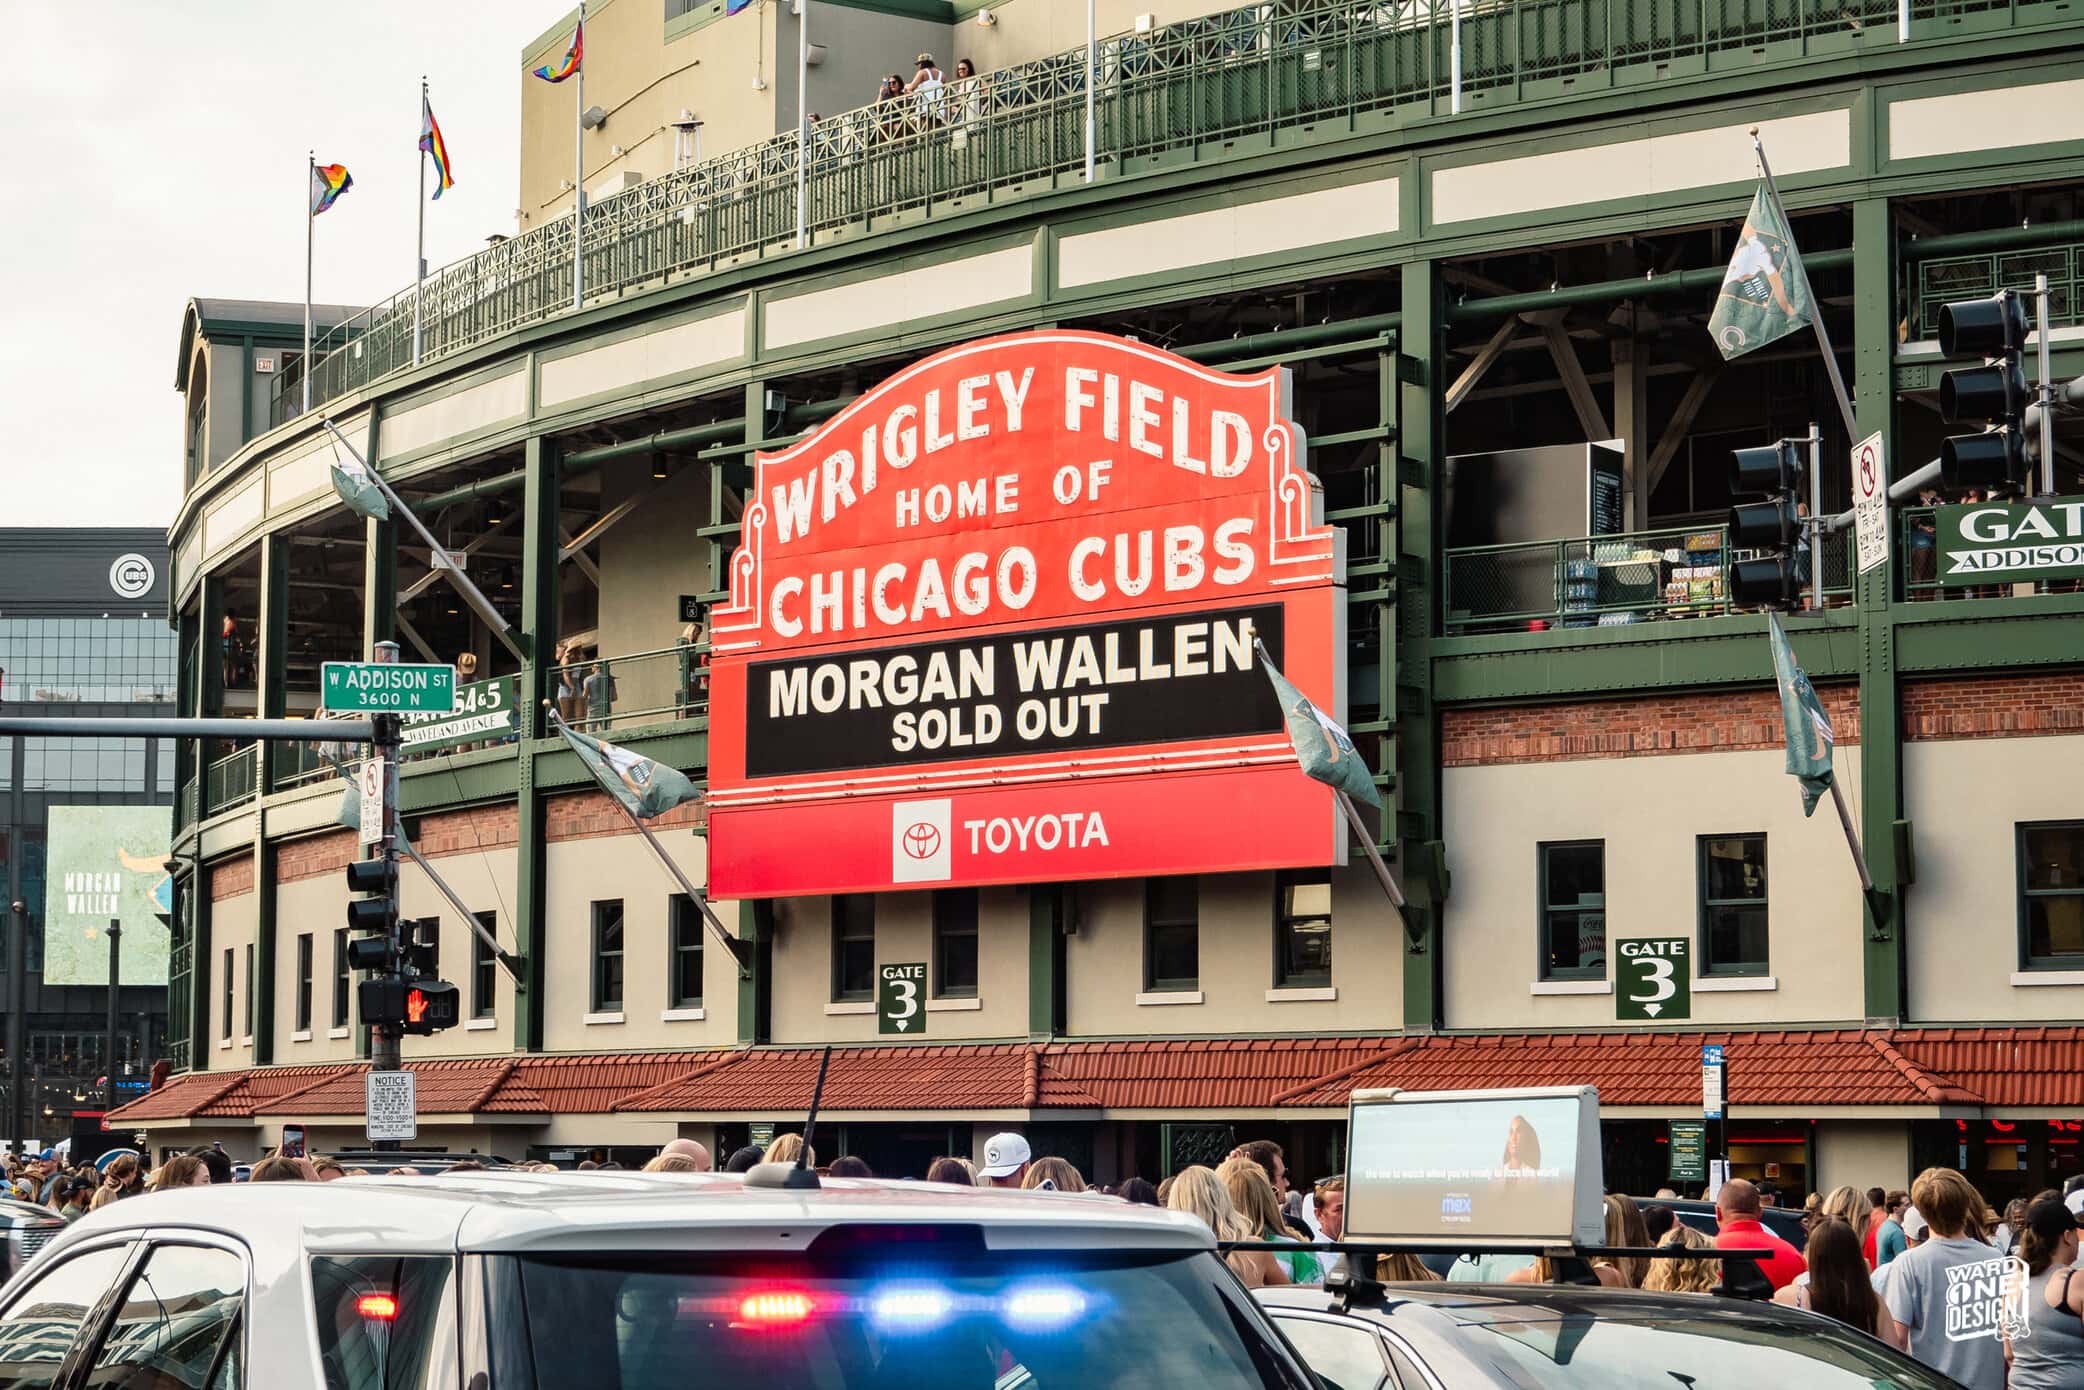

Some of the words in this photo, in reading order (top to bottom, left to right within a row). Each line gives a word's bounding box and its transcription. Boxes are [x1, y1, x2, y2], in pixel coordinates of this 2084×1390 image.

[772, 367, 1034, 543] WRIGLEY
[1065, 367, 1253, 478] FIELD
[896, 474, 1019, 527] HOME
[1053, 460, 1113, 504] OF
[1961, 545, 2084, 569] ADDISO
[769, 546, 1036, 637] CHICAGO
[1068, 518, 1255, 602] CUBS
[769, 646, 995, 718] MORGAN
[1013, 617, 1254, 696] WALLEN
[330, 672, 340, 686] W
[346, 671, 428, 690] ADDISON
[433, 674, 448, 687] ST
[359, 693, 401, 705] 3600
[410, 694, 420, 706] N
[409, 721, 459, 741] WAVELAND
[460, 714, 496, 734] AVENUE
[891, 710, 1002, 752] SOLD
[1016, 693, 1109, 739] OUT
[964, 811, 1109, 855] TOYOTA
[64, 872, 120, 893] MORGAN
[67, 894, 117, 915] WALLEN
[1620, 941, 1684, 956] GATE
[882, 966, 924, 979] GATE
[1630, 957, 1676, 1002] 3
[888, 980, 917, 1018] 3
[375, 1076, 406, 1085] NOTICE
[1442, 1198, 1472, 1213] max
